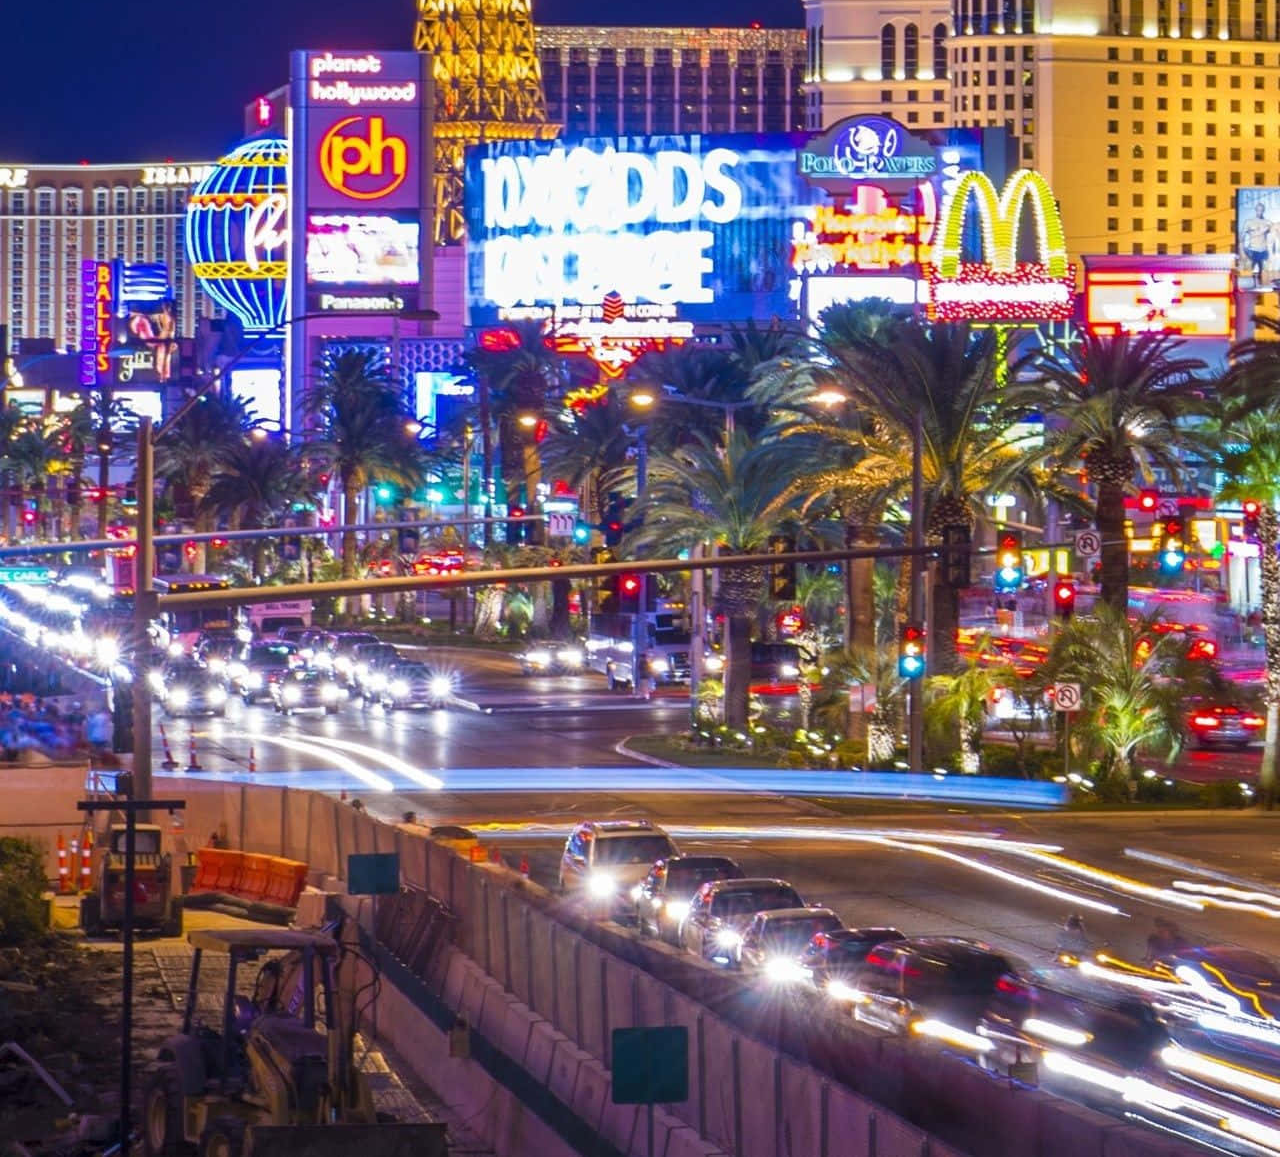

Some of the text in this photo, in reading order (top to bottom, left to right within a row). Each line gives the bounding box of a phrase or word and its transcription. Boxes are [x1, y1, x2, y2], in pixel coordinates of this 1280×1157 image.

[311, 53, 381, 78] planet
[311, 80, 416, 105] hollywood
[328, 116, 408, 190] ph
[97, 266, 110, 372] BALLY'S
